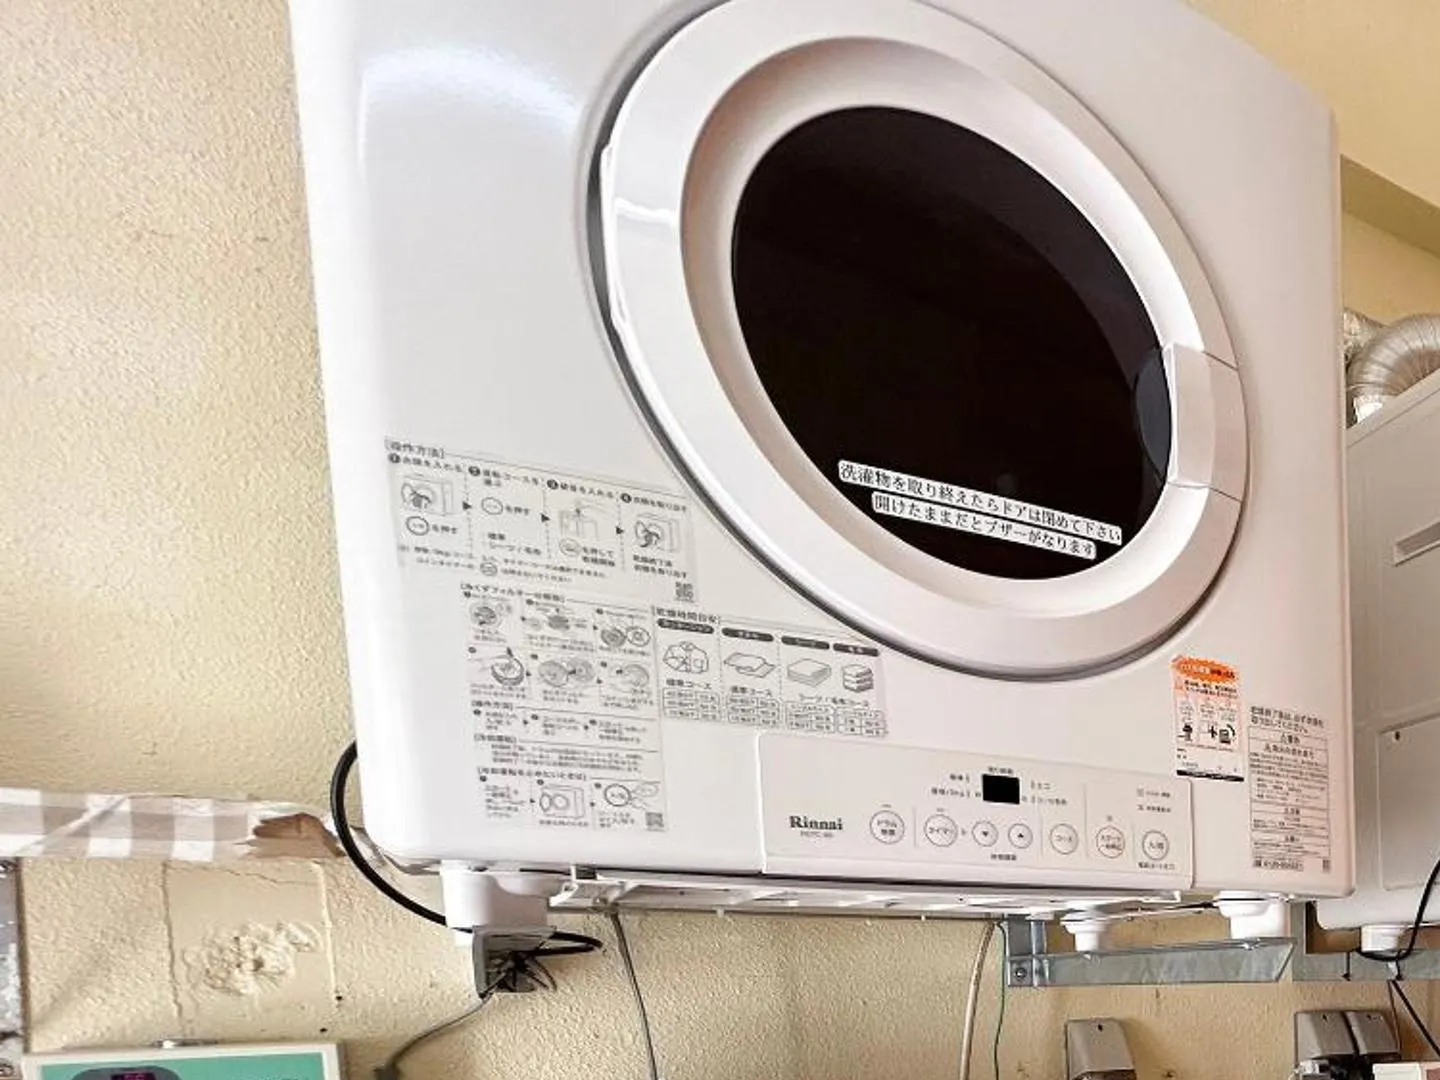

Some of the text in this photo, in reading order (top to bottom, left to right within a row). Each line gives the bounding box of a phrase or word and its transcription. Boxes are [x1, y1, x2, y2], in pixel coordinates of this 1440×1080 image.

[874, 494, 1095, 556] 開けたままだとブザーがなります
[789, 815, 843, 831] Rinnai
